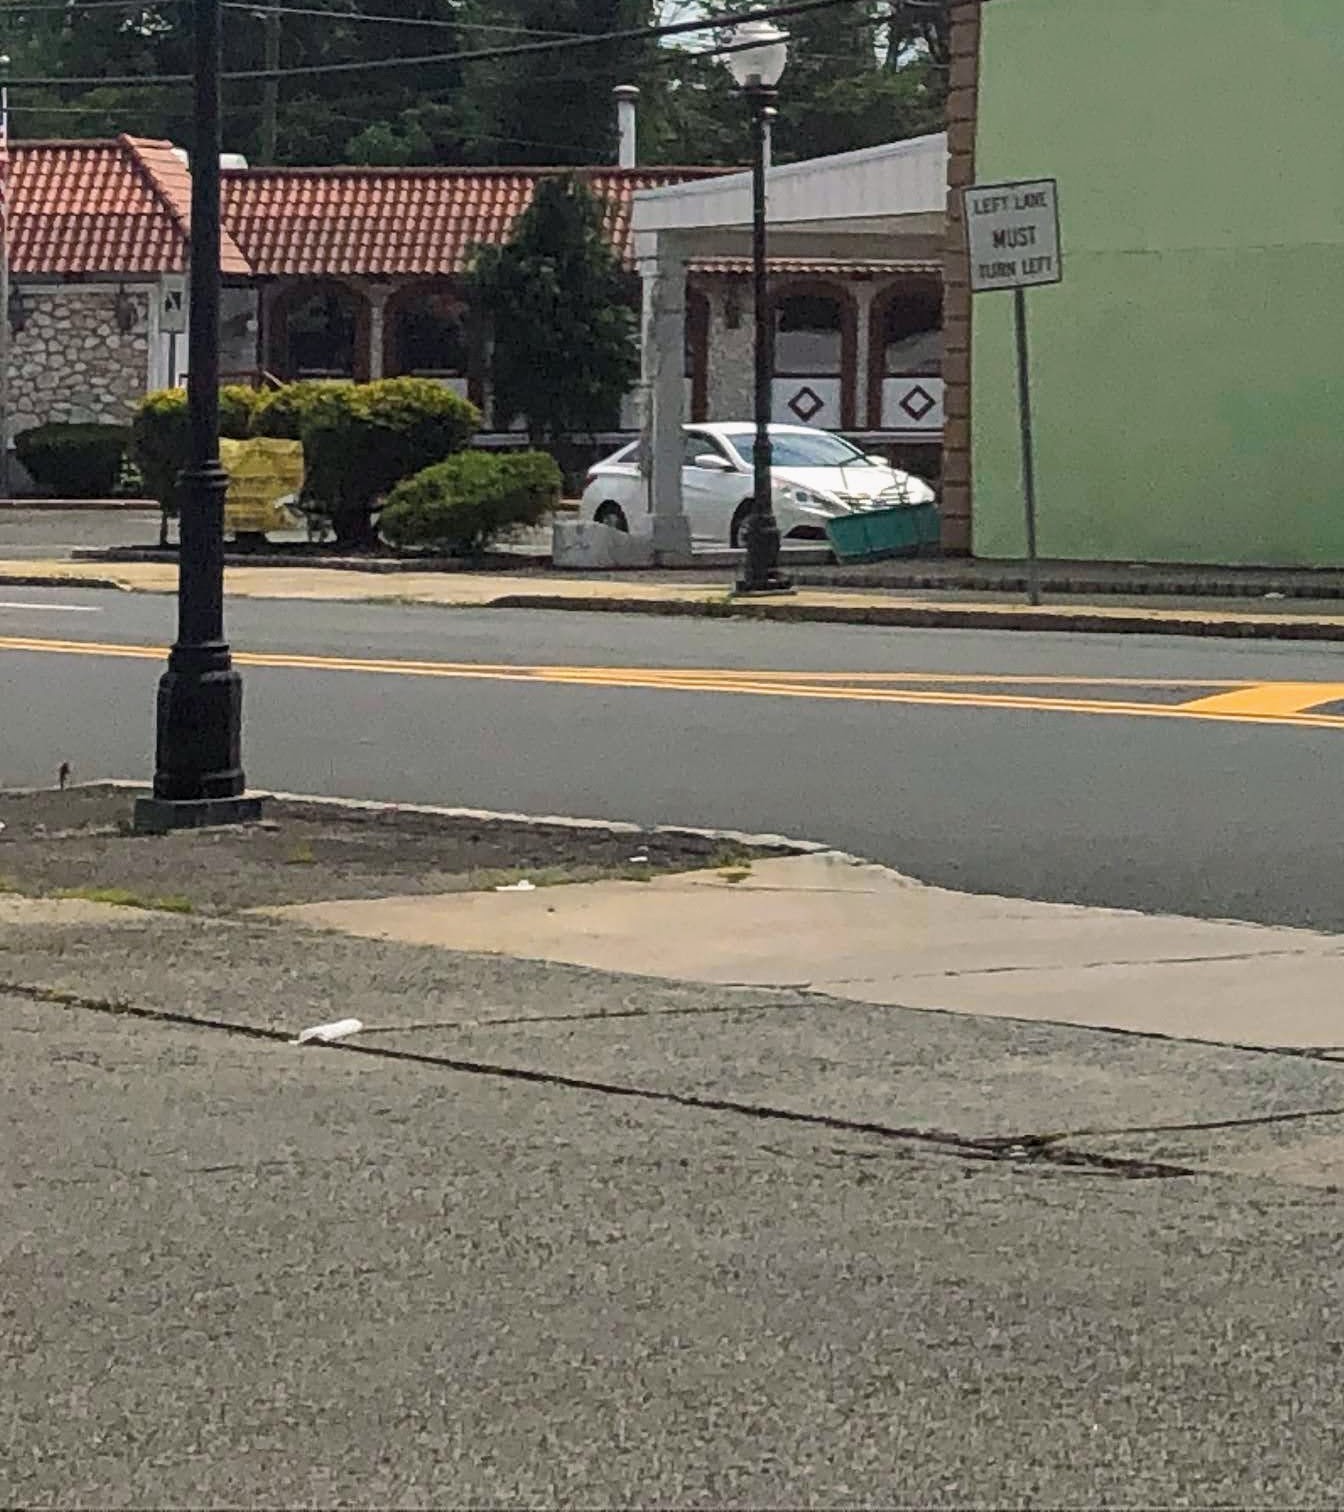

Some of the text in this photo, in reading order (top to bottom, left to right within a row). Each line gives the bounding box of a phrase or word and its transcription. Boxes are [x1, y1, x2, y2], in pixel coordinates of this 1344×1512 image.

[975, 191, 1048, 215] LEFT LANE
[992, 225, 1036, 248] MUST
[978, 255, 1052, 279] TURN LEFT
